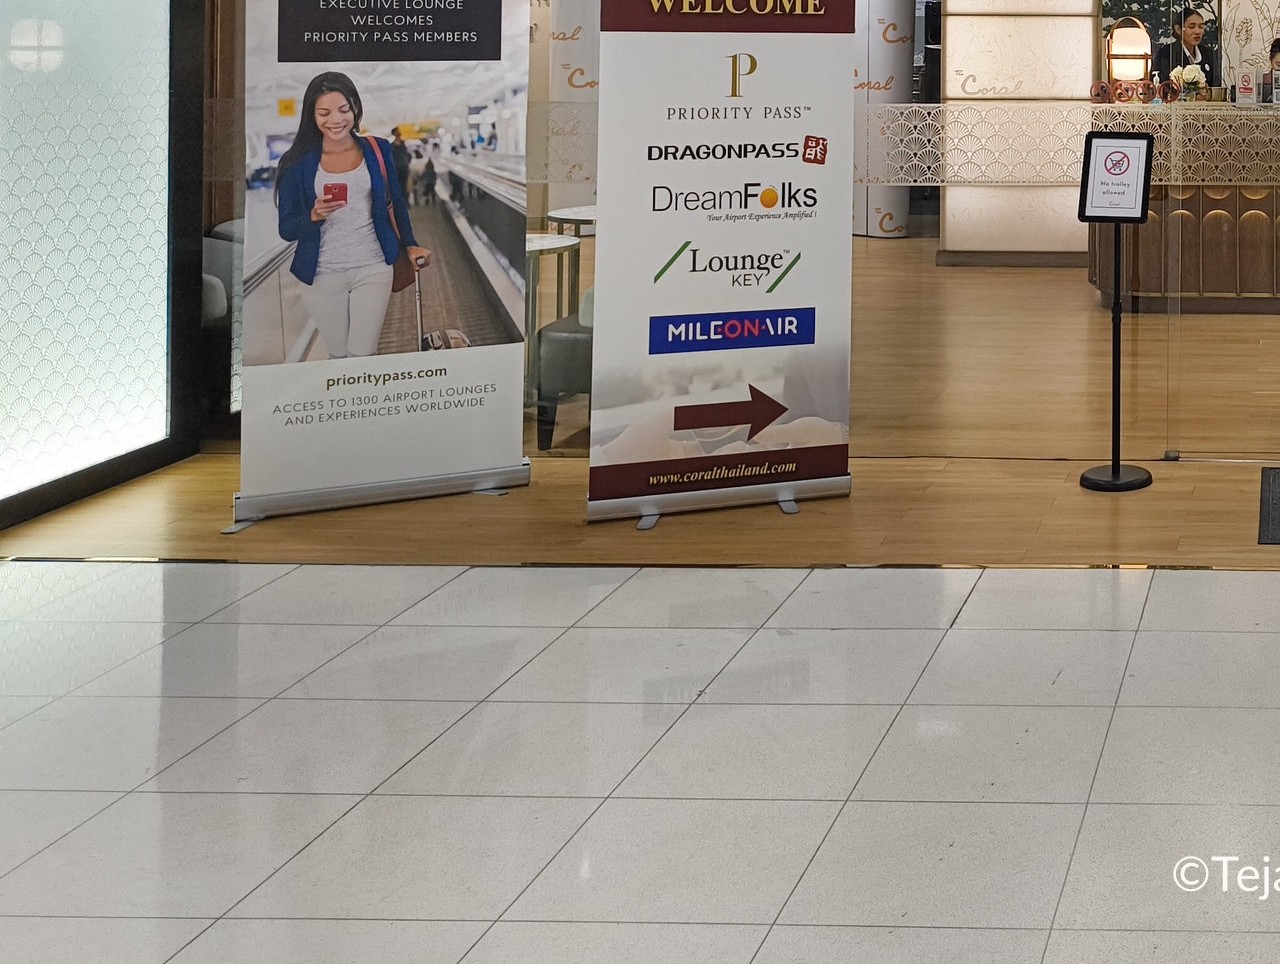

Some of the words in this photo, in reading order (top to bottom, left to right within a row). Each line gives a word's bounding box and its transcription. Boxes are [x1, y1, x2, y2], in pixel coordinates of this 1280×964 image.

[405, 0, 464, 10] LOUNGE
[351, 15, 433, 26] WELCOMES
[304, 32, 368, 43] PRIORITY
[374, 32, 409, 42] PASS
[414, 32, 477, 42] MEMBERS
[961, 74, 1023, 95] Coral
[667, 107, 753, 120] PRIORITY
[648, 143, 799, 161] DRAGONPASS
[652, 182, 817, 211] DreamFolks
[707, 214, 723, 222] Your
[723, 213, 747, 222] Airport
[748, 212, 781, 222] Experience
[732, 274, 764, 287] KEY
[326, 367, 447, 391] prioritypass.com
[272, 400, 324, 415] ACCESS
[329, 398, 347, 409] TO
[350, 395, 379, 407] 1300
[383, 389, 435, 403] AIRPORT
[439, 383, 497, 398] LOUNGES
[285, 414, 314, 426] AND
[318, 406, 400, 423] EXPERIENCES
[405, 397, 485, 414] WORLDWIDE
[649, 461, 796, 485] www.coralthailand.com
